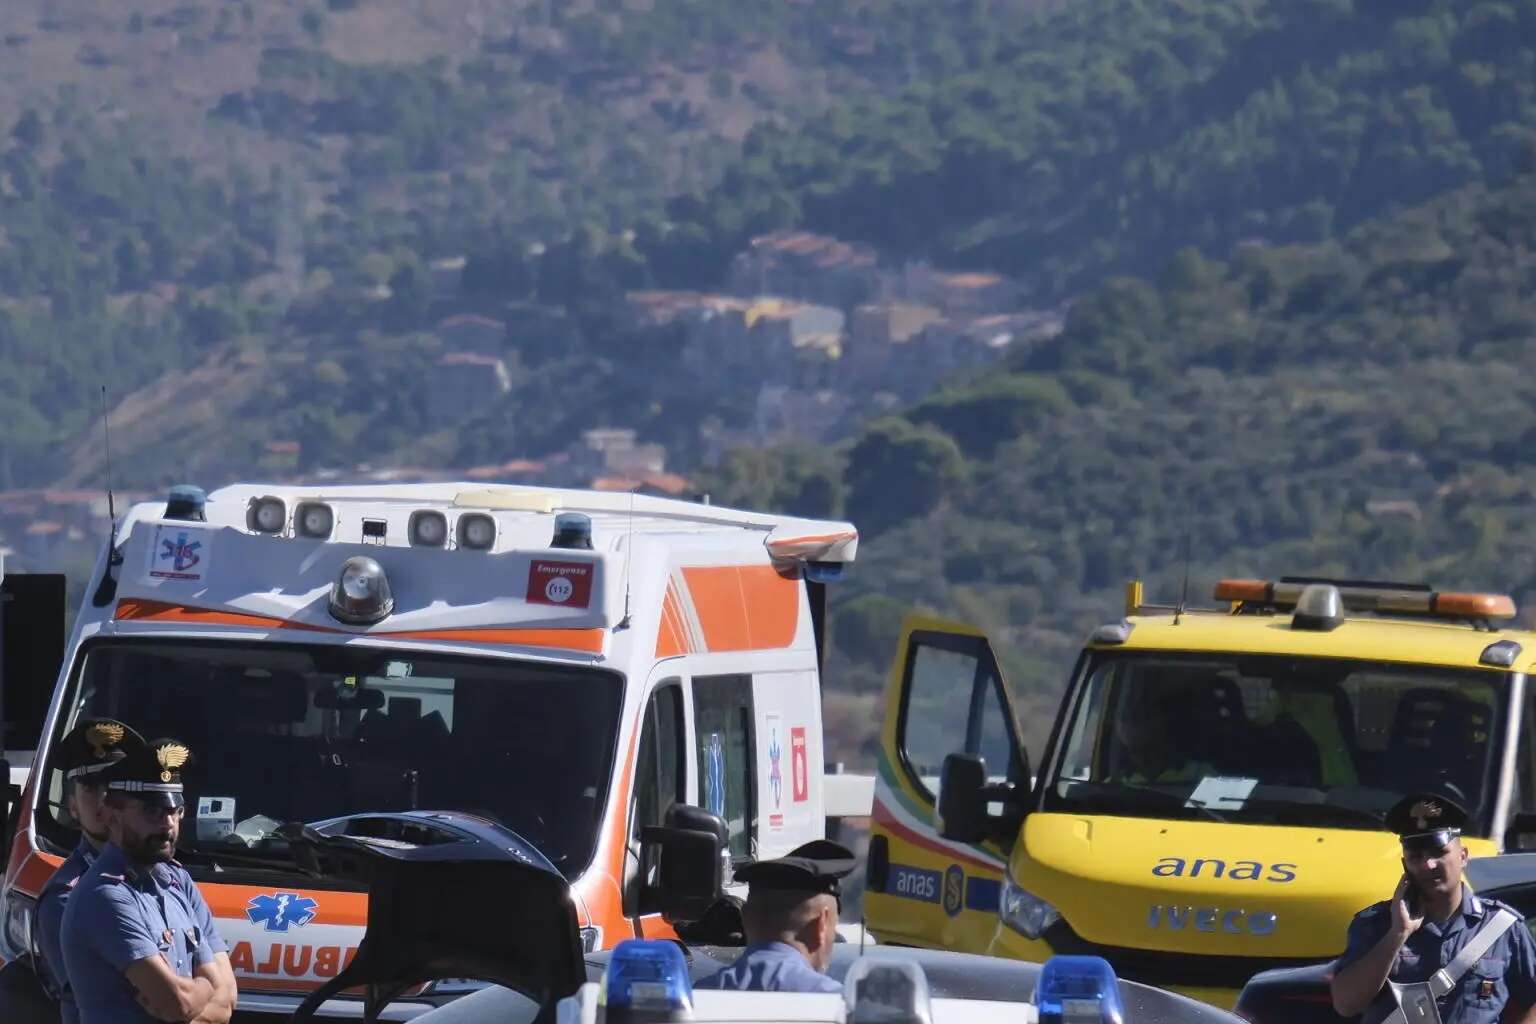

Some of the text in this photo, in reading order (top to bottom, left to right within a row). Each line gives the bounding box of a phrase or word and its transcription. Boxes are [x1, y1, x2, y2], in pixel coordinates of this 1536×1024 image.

[1151, 857, 1299, 883] anas
[896, 871, 935, 898] anas
[1147, 904, 1279, 936] IVECO
